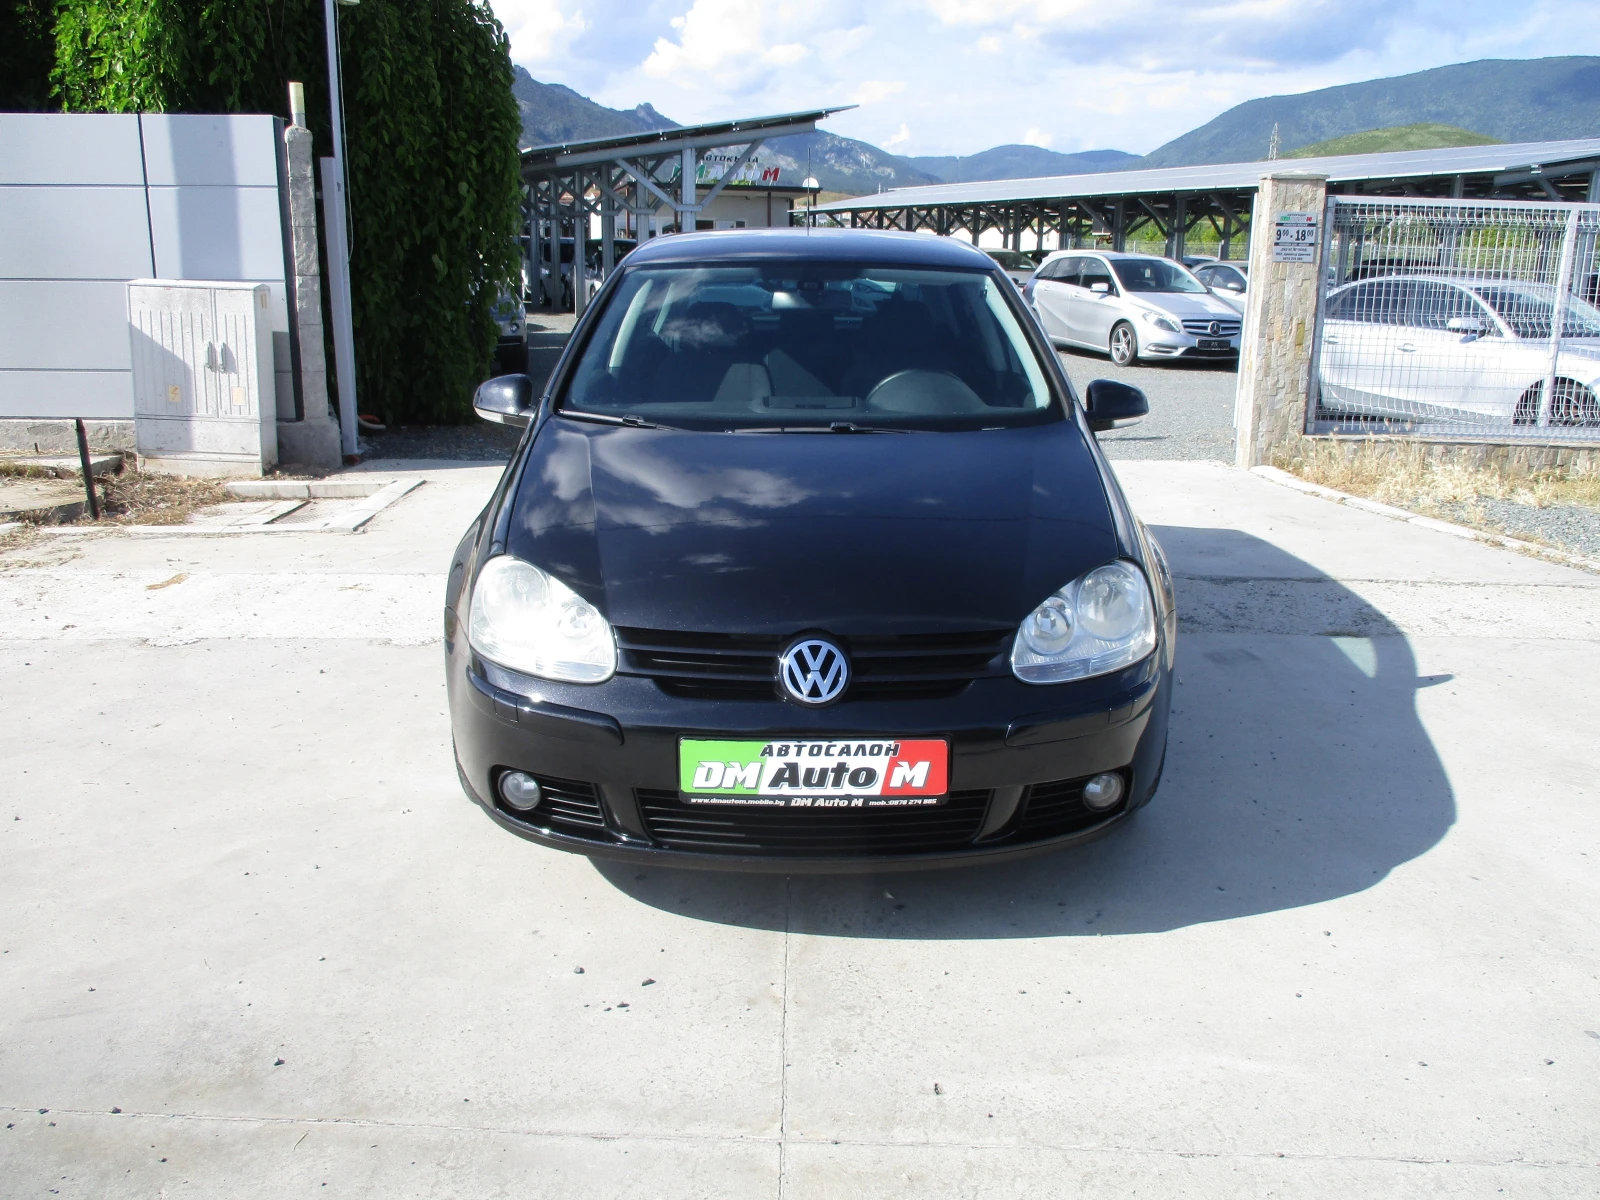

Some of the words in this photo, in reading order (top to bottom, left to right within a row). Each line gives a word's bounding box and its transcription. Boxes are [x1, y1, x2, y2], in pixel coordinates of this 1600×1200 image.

[702, 154, 759, 164] ВТОКЪА
[783, 640, 848, 704] VW
[759, 743, 901, 758] АВТОСАЛОН
[692, 761, 764, 790] DM
[767, 761, 879, 790] Auto
[889, 761, 932, 789] M
[790, 797, 813, 807] DM
[814, 797, 849, 807] Auto
[851, 798, 864, 807] M
